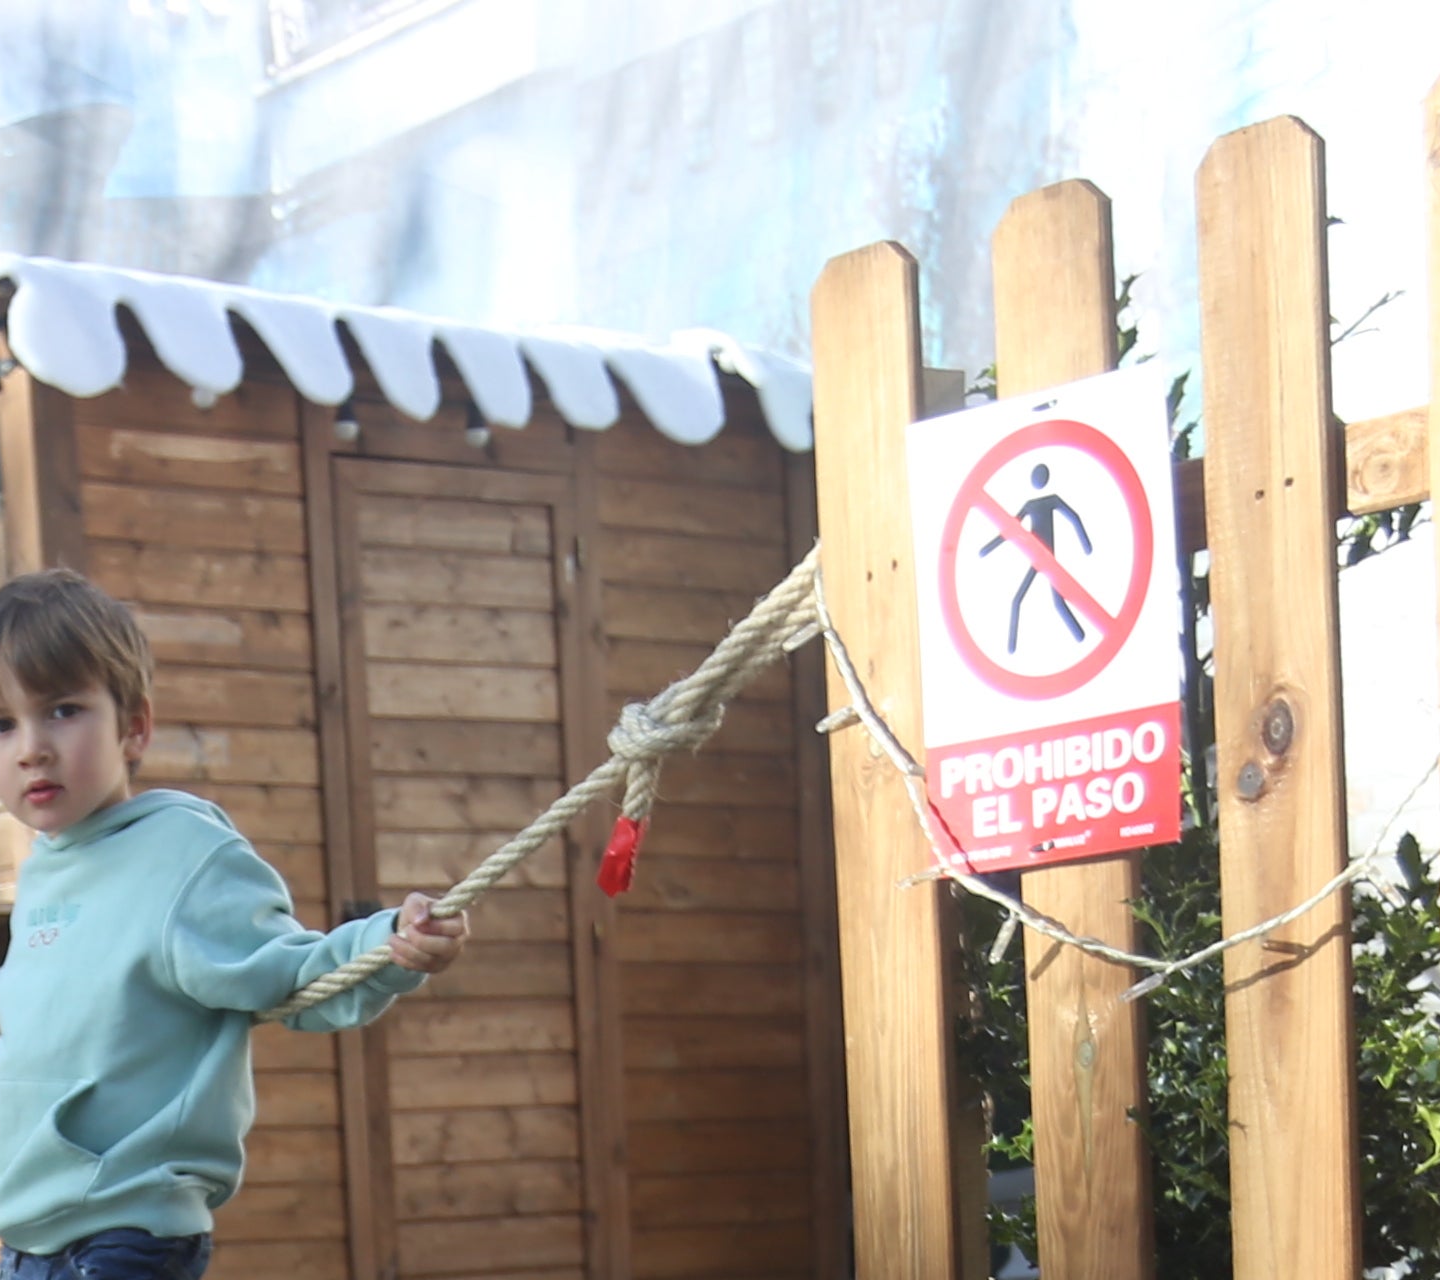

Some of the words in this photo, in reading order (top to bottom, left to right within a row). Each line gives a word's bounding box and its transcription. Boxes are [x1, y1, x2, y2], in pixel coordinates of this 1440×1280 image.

[940, 721, 1166, 799] PROHIBIDO
[972, 794, 1023, 838] EL
[1031, 771, 1145, 828] PASO
